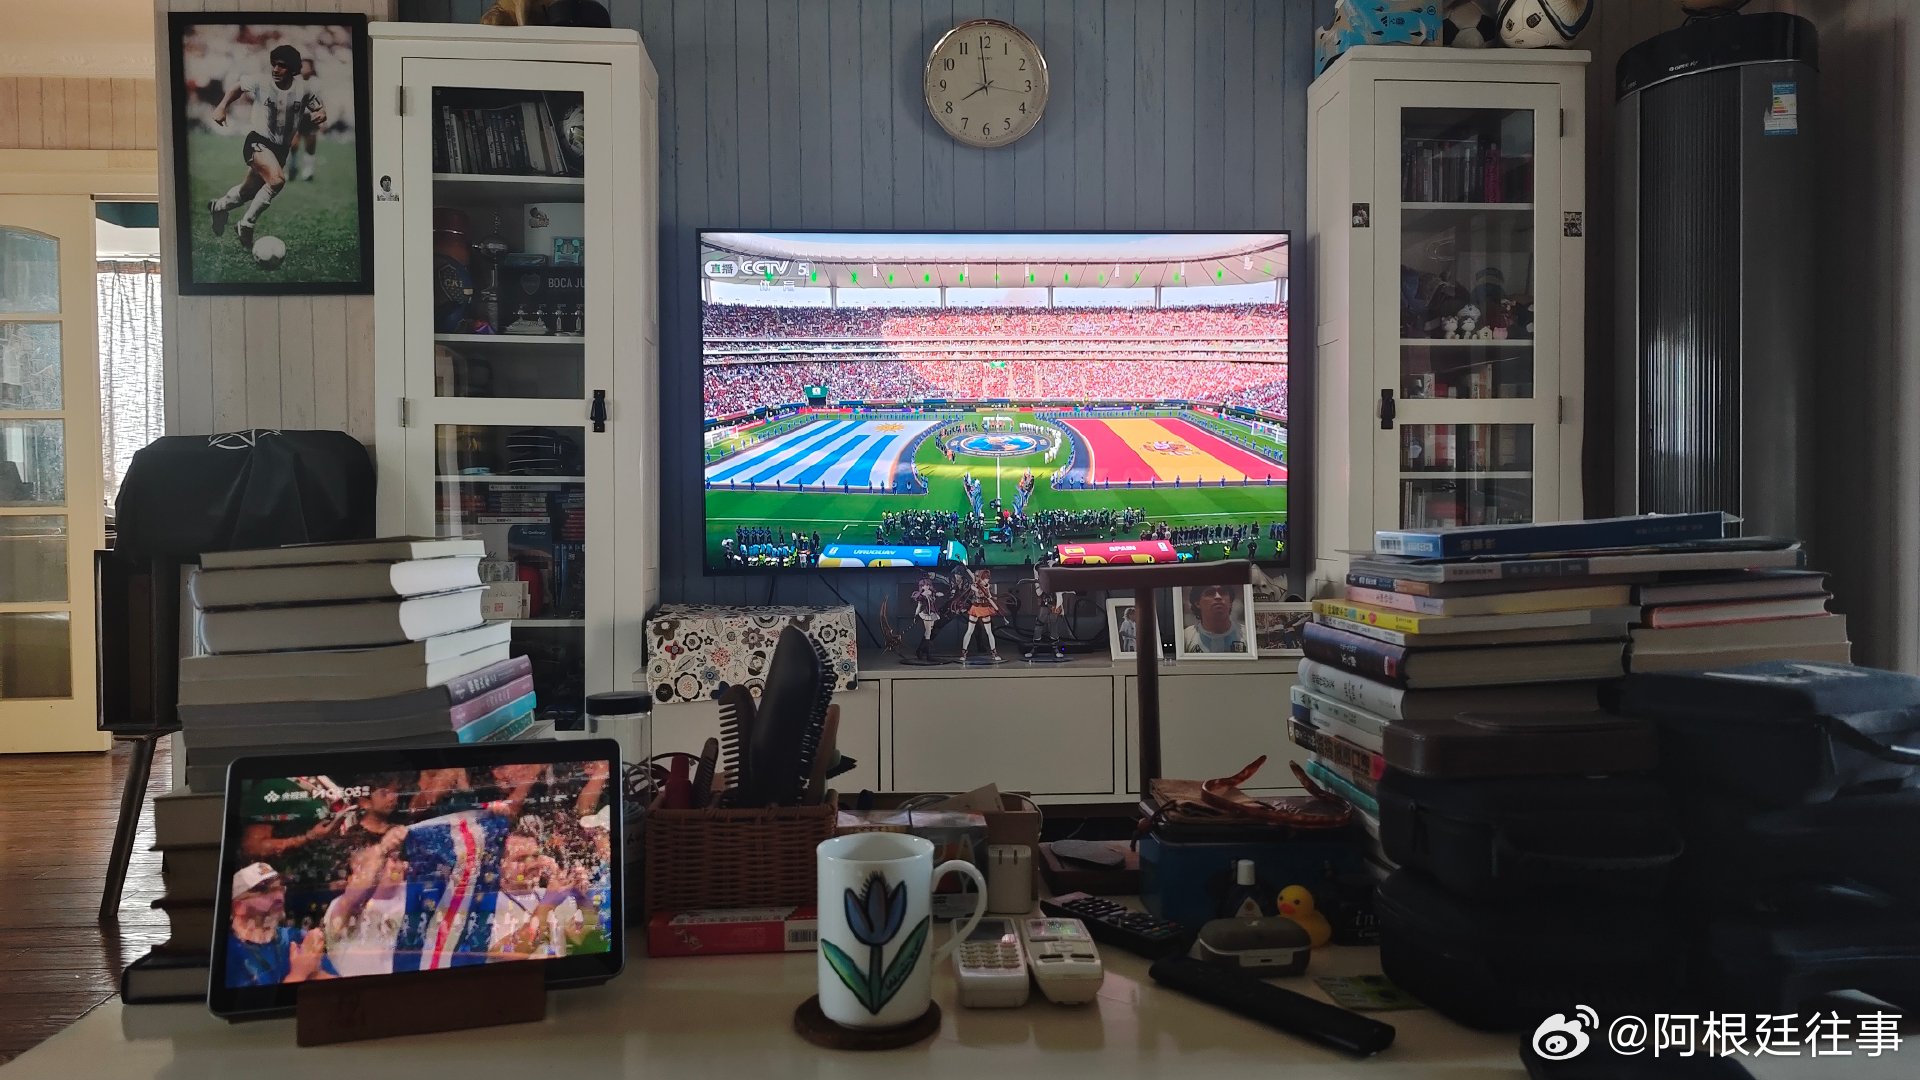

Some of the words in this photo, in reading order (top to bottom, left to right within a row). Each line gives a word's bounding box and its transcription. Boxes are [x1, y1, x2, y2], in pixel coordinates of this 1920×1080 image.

[959, 42, 968, 55] 11
[1004, 42, 1008, 55] 1
[943, 58, 955, 71] 10
[1018, 58, 1026, 71] 2
[939, 79, 947, 92] 9
[1024, 79, 1032, 92] 3
[945, 101, 953, 114] 8
[1018, 101, 1026, 114] 4
[960, 117, 968, 130] 7
[982, 122, 990, 136] 6
[1003, 117, 1011, 130] 5
[710, 263, 734, 274] 直播
[740, 260, 790, 275] CCTV
[548, 277, 573, 288] BOCA
